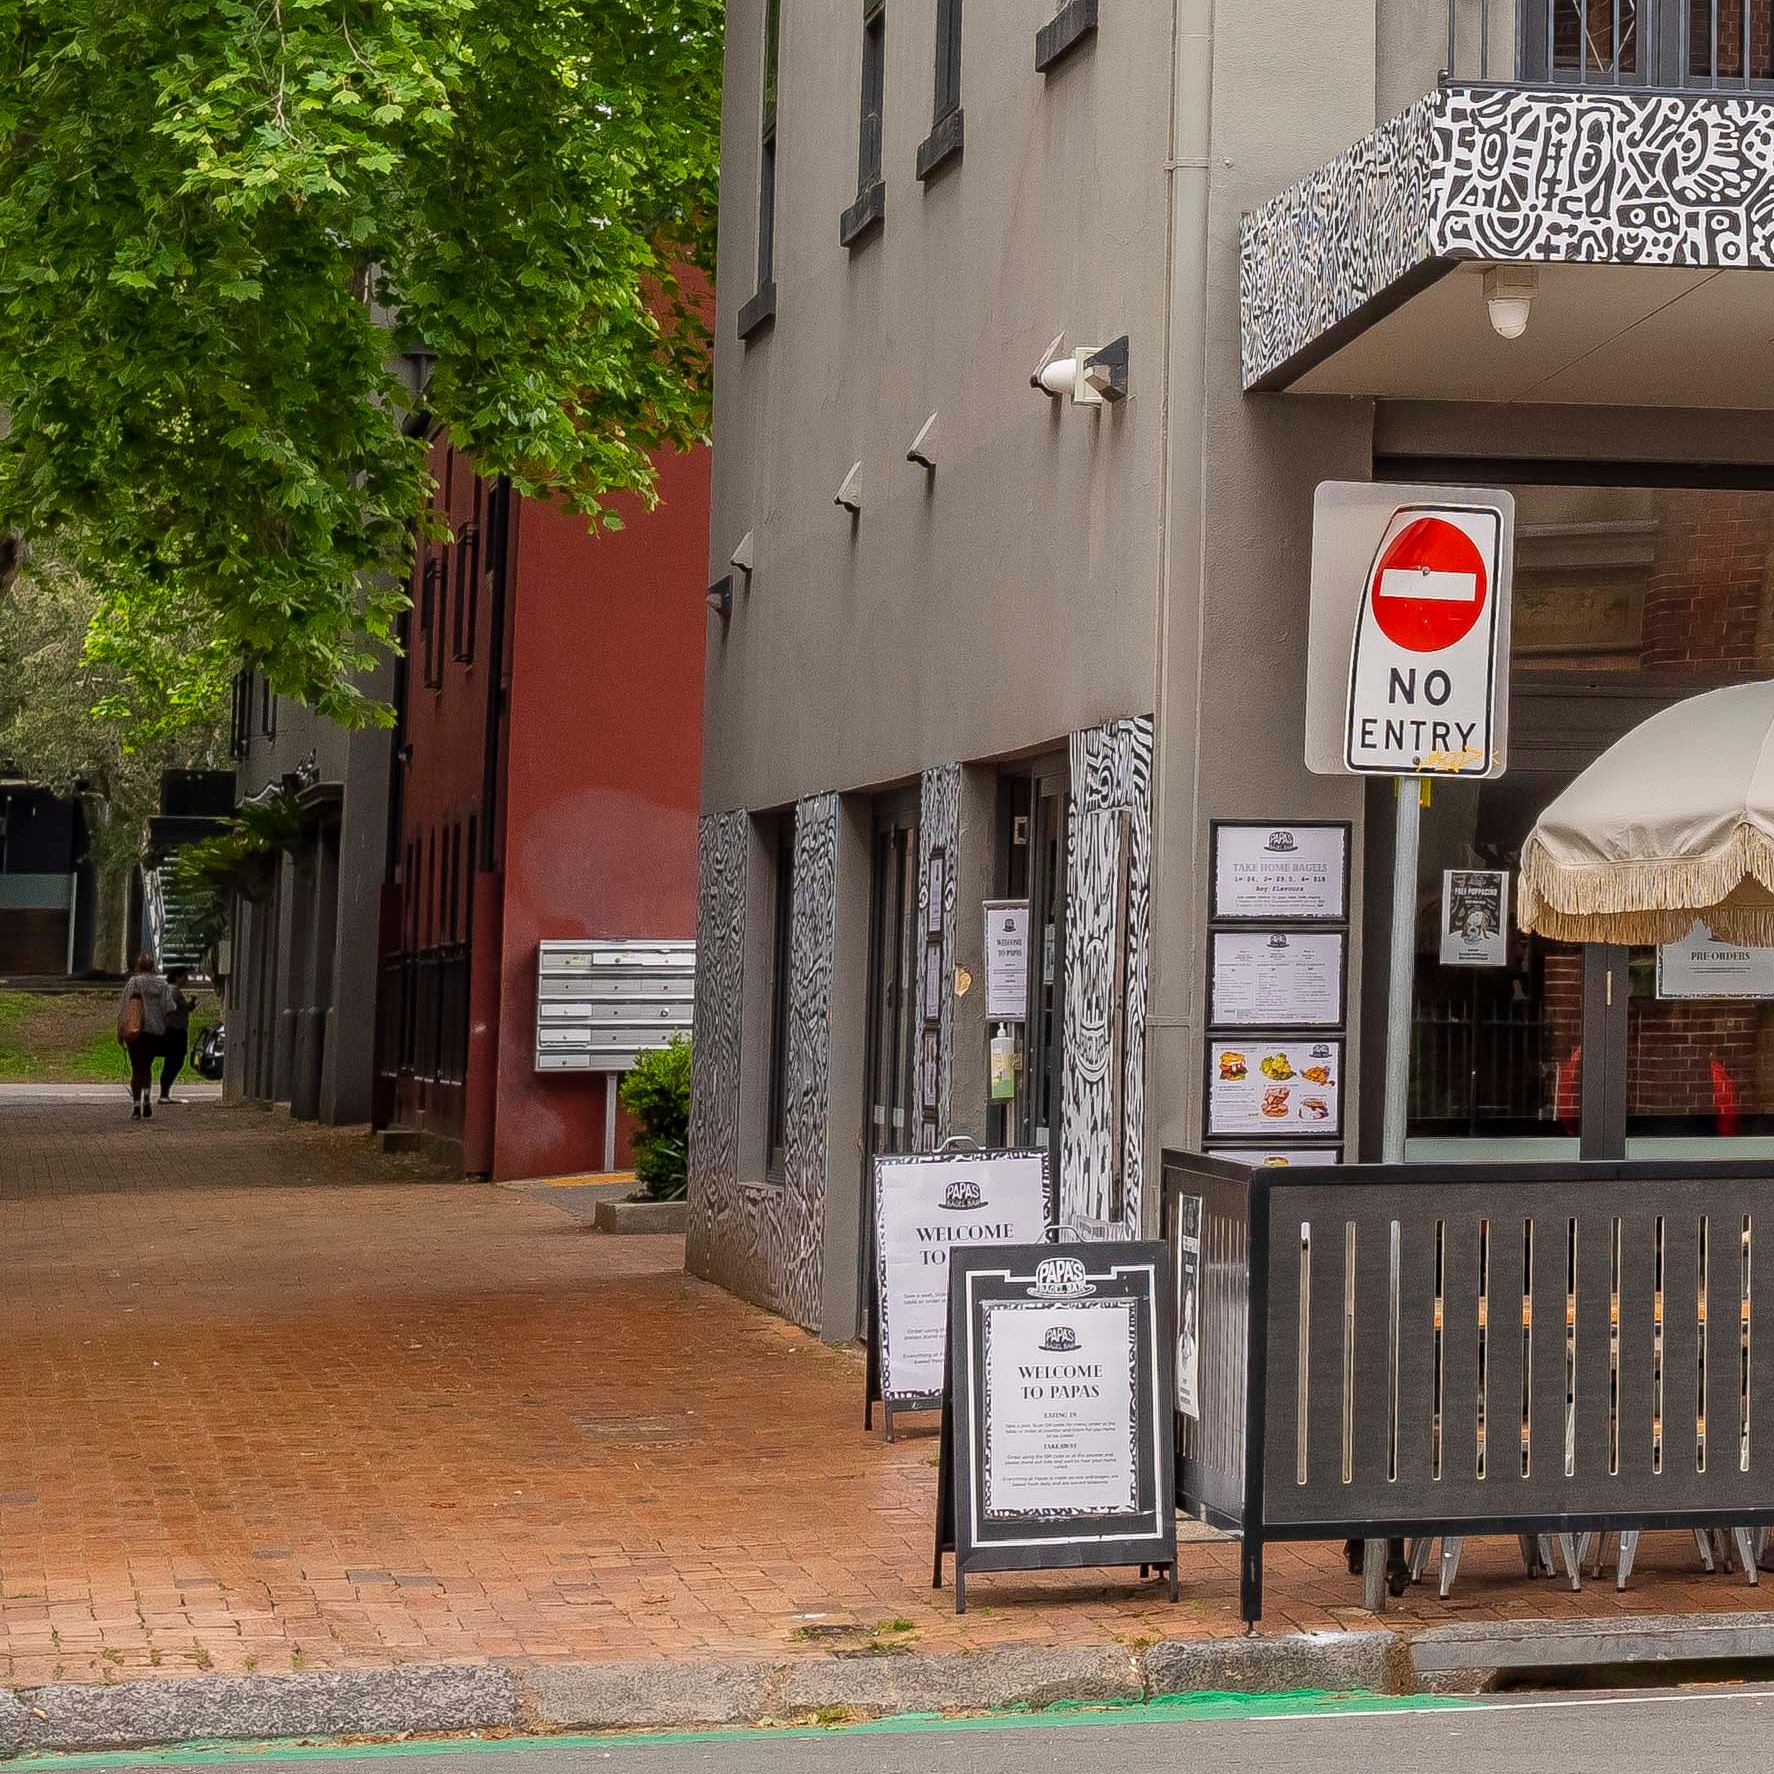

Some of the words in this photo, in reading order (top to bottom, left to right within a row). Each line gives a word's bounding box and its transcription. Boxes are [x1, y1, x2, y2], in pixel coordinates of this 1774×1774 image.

[1388, 667, 1452, 707] NO
[1360, 718, 1477, 753] ENTRY
[1232, 863, 1257, 873] TAKE
[1260, 863, 1290, 873] HOME
[1292, 863, 1328, 873] BAGELS
[1691, 951, 1751, 961] PRE-ORDERS
[946, 1182, 980, 1200] PAPA'S
[916, 1223, 1014, 1242] WELCOME
[920, 1250, 946, 1265] TO
[1039, 1260, 1083, 1283] PAPA'S
[1018, 1364, 1103, 1379] WELCOME
[1021, 1386, 1043, 1399] TO
[1051, 1385, 1100, 1399] PAPAS
